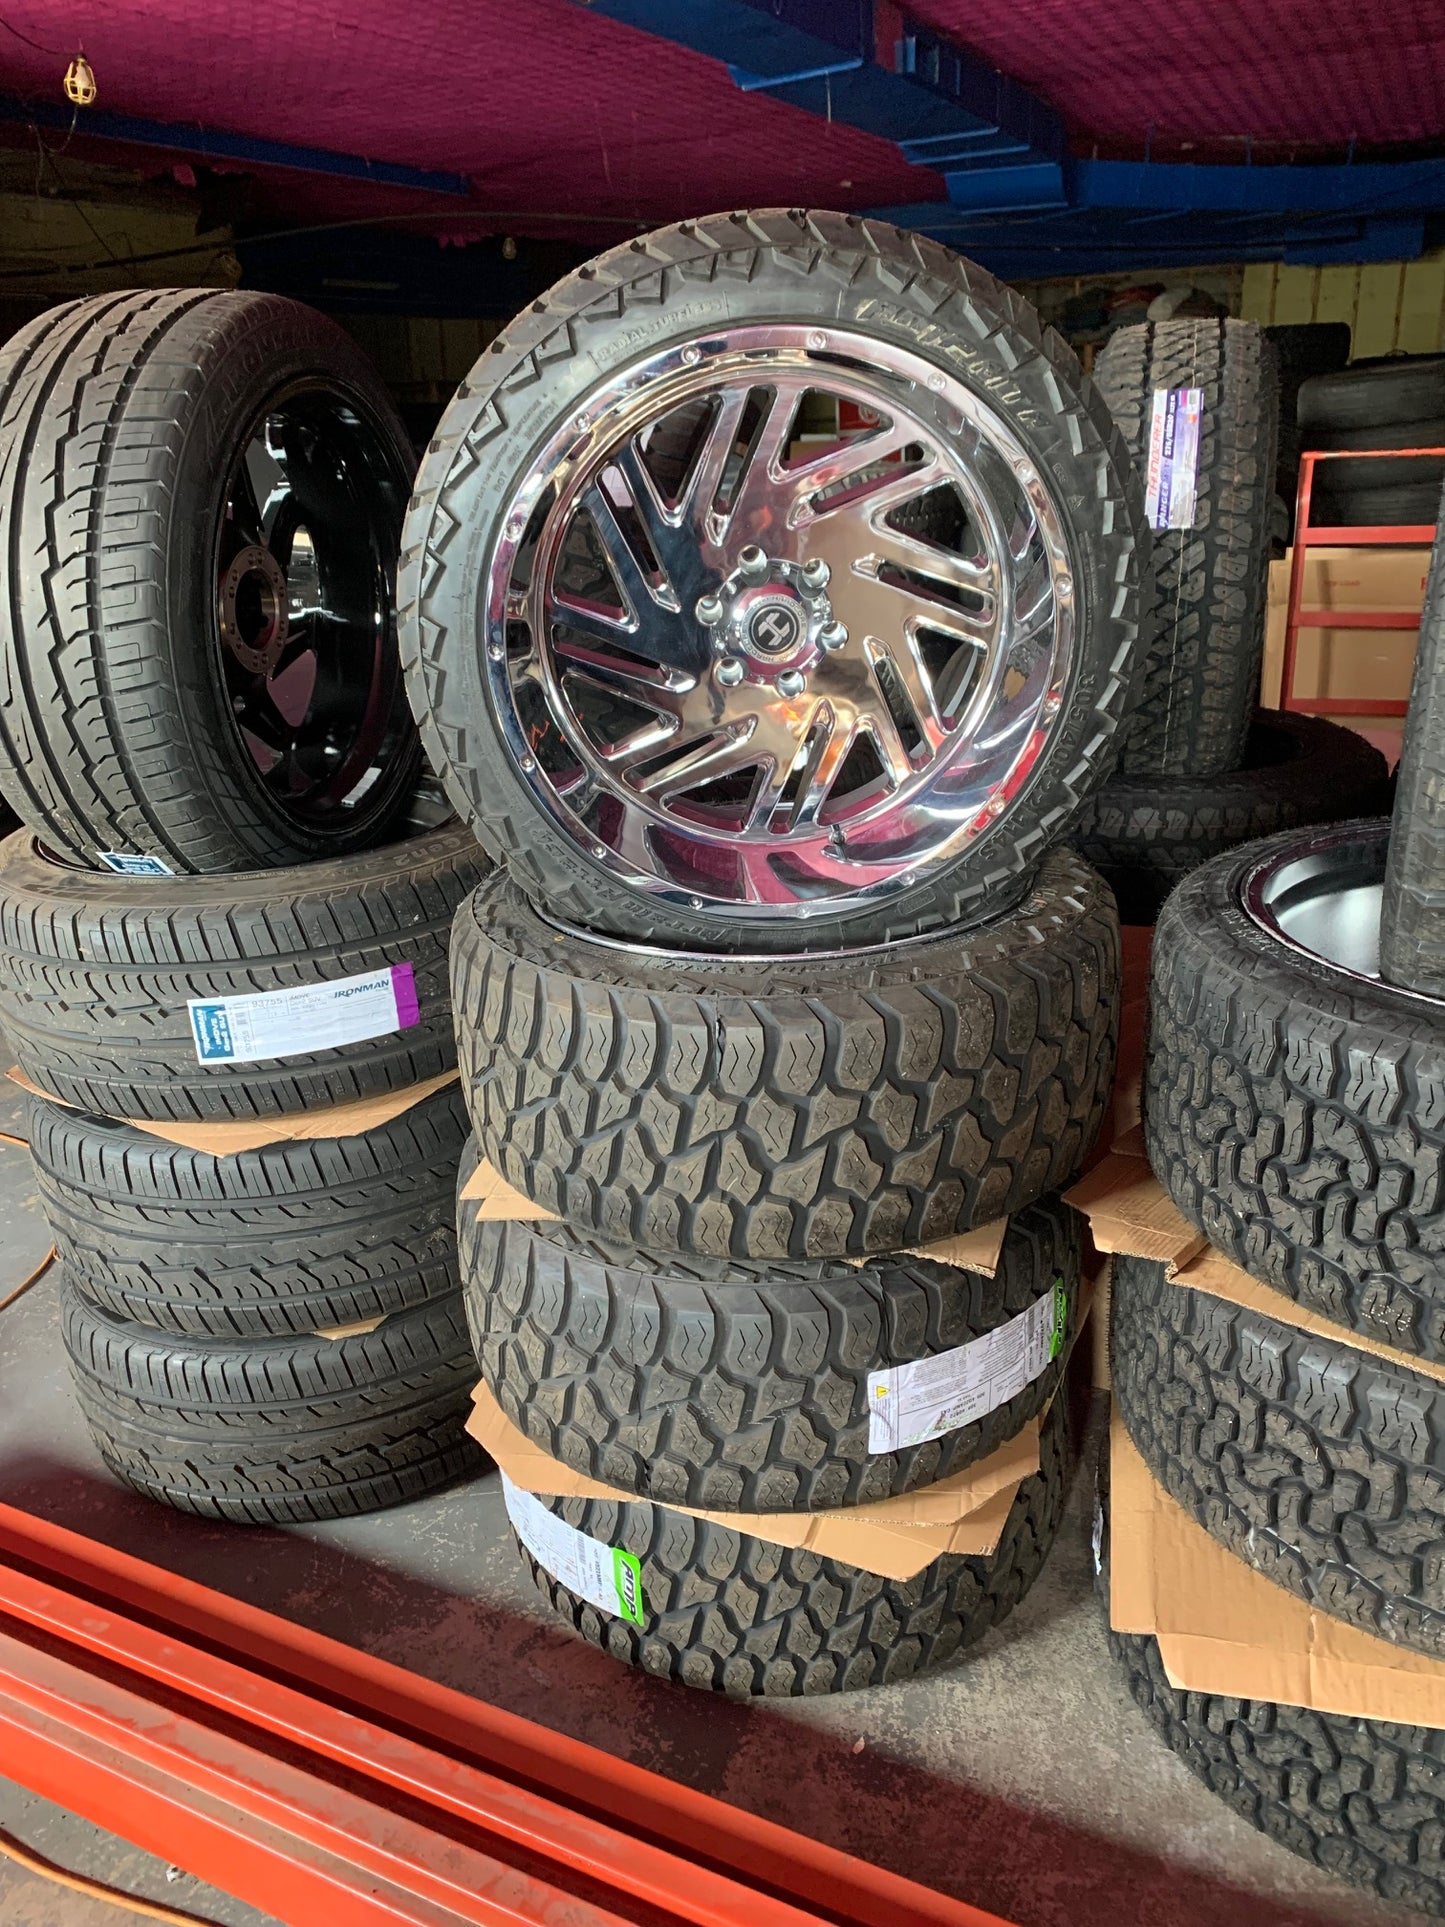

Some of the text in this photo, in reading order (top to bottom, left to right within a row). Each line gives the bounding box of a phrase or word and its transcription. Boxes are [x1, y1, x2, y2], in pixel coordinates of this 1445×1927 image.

[595, 323, 648, 362] RADIAL
[392, 837, 461, 867] Gen2
[252, 998, 283, 1008] 93755
[334, 979, 390, 998] IRONMAN
[620, 1559, 637, 1618] AMP
